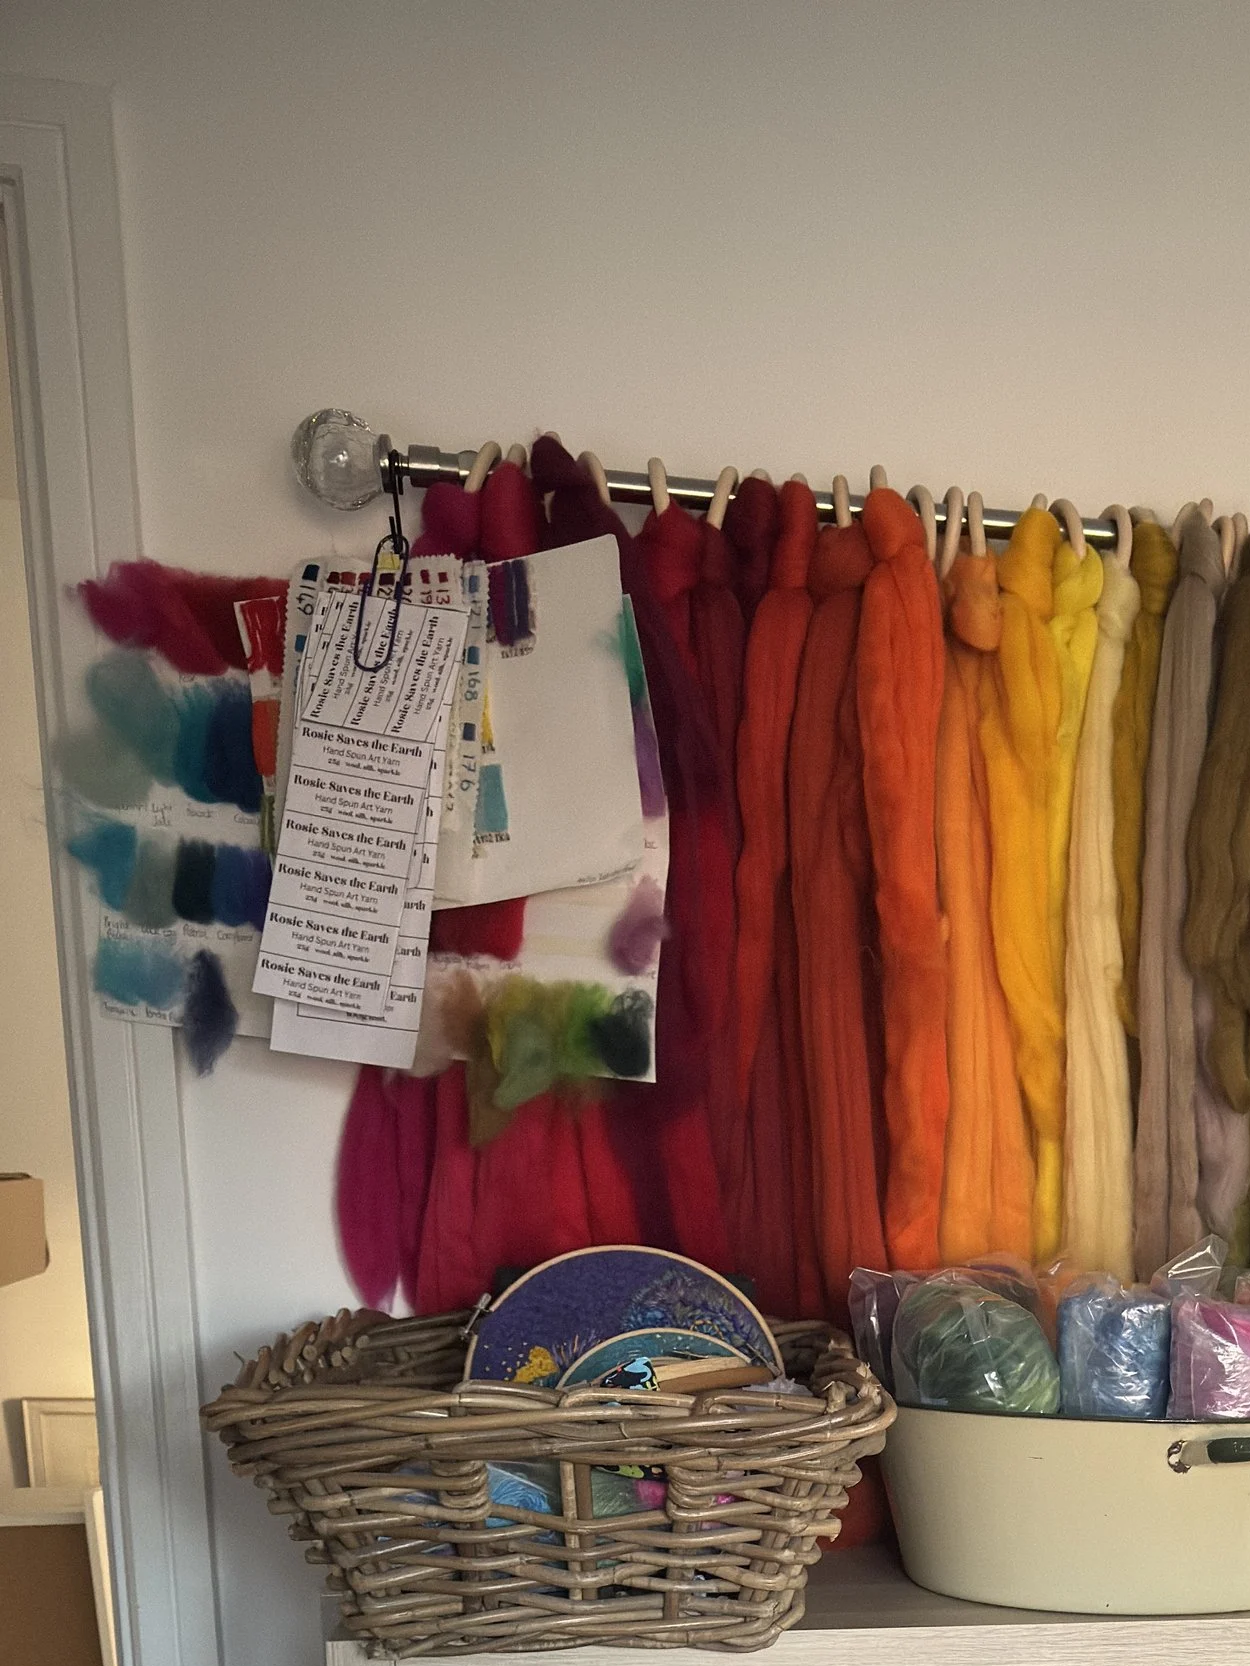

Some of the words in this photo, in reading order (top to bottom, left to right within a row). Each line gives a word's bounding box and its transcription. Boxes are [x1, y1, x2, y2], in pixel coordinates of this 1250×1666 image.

[297, 585, 316, 615] 149
[436, 588, 450, 605] 13
[341, 601, 359, 632] Earth
[335, 633, 348, 651] the
[324, 653, 341, 687] Saves
[350, 696, 370, 726] Rosie
[364, 661, 381, 694] Savs
[374, 640, 387, 658] the
[391, 703, 411, 733] Rosie
[404, 669, 422, 701] Saves
[415, 649, 428, 667] the
[422, 616, 439, 647] Earth
[310, 688, 330, 718] Rosie
[302, 727, 334, 742] Rosie
[337, 733, 369, 748] Saves
[372, 739, 389, 752] the
[391, 742, 422, 757] Earth
[323, 746, 344, 757] Hand
[346, 750, 366, 761] Spun
[368, 753, 381, 762] Art
[382, 756, 400, 766] Yarn
[294, 774, 326, 789] Rosie
[329, 780, 361, 796] Saves
[364, 787, 381, 800] the
[383, 791, 414, 806] Earth
[315, 793, 336, 805] Hand
[338, 797, 358, 809] Spun
[360, 801, 373, 811] Art
[374, 803, 393, 814] Yarn
[286, 819, 319, 835] Rosie
[321, 825, 354, 841] Saves
[356, 832, 373, 844] the
[375, 836, 406, 851] Earth
[308, 838, 329, 850] Hand
[331, 843, 351, 854] Spun
[353, 847, 366, 856] Art
[367, 849, 385, 860] Yarn
[278, 863, 311, 879] Rosie
[314, 870, 347, 885] Saves
[350, 877, 366, 890] the
[369, 880, 399, 895] Earth
[300, 883, 322, 894] Hand
[323, 887, 344, 899] Spun
[346, 891, 359, 901] Art
[360, 893, 378, 904] Yarn
[403, 900, 426, 911] arth
[269, 912, 303, 928] Rosie
[305, 919, 339, 935] Saves
[341, 926, 358, 939] the
[360, 930, 389, 944] Earth
[292, 931, 313, 943] Hand
[315, 936, 336, 948] Spun
[338, 940, 351, 949] Art
[352, 943, 370, 953] Yarn
[261, 958, 295, 974] Rosie
[297, 966, 331, 982] Saves
[334, 973, 350, 985] the
[352, 976, 381, 991] Earth
[283, 978, 306, 990] Hand
[307, 982, 329, 994] Spun
[331, 986, 343, 996] Art
[344, 989, 362, 1000] Yarn
